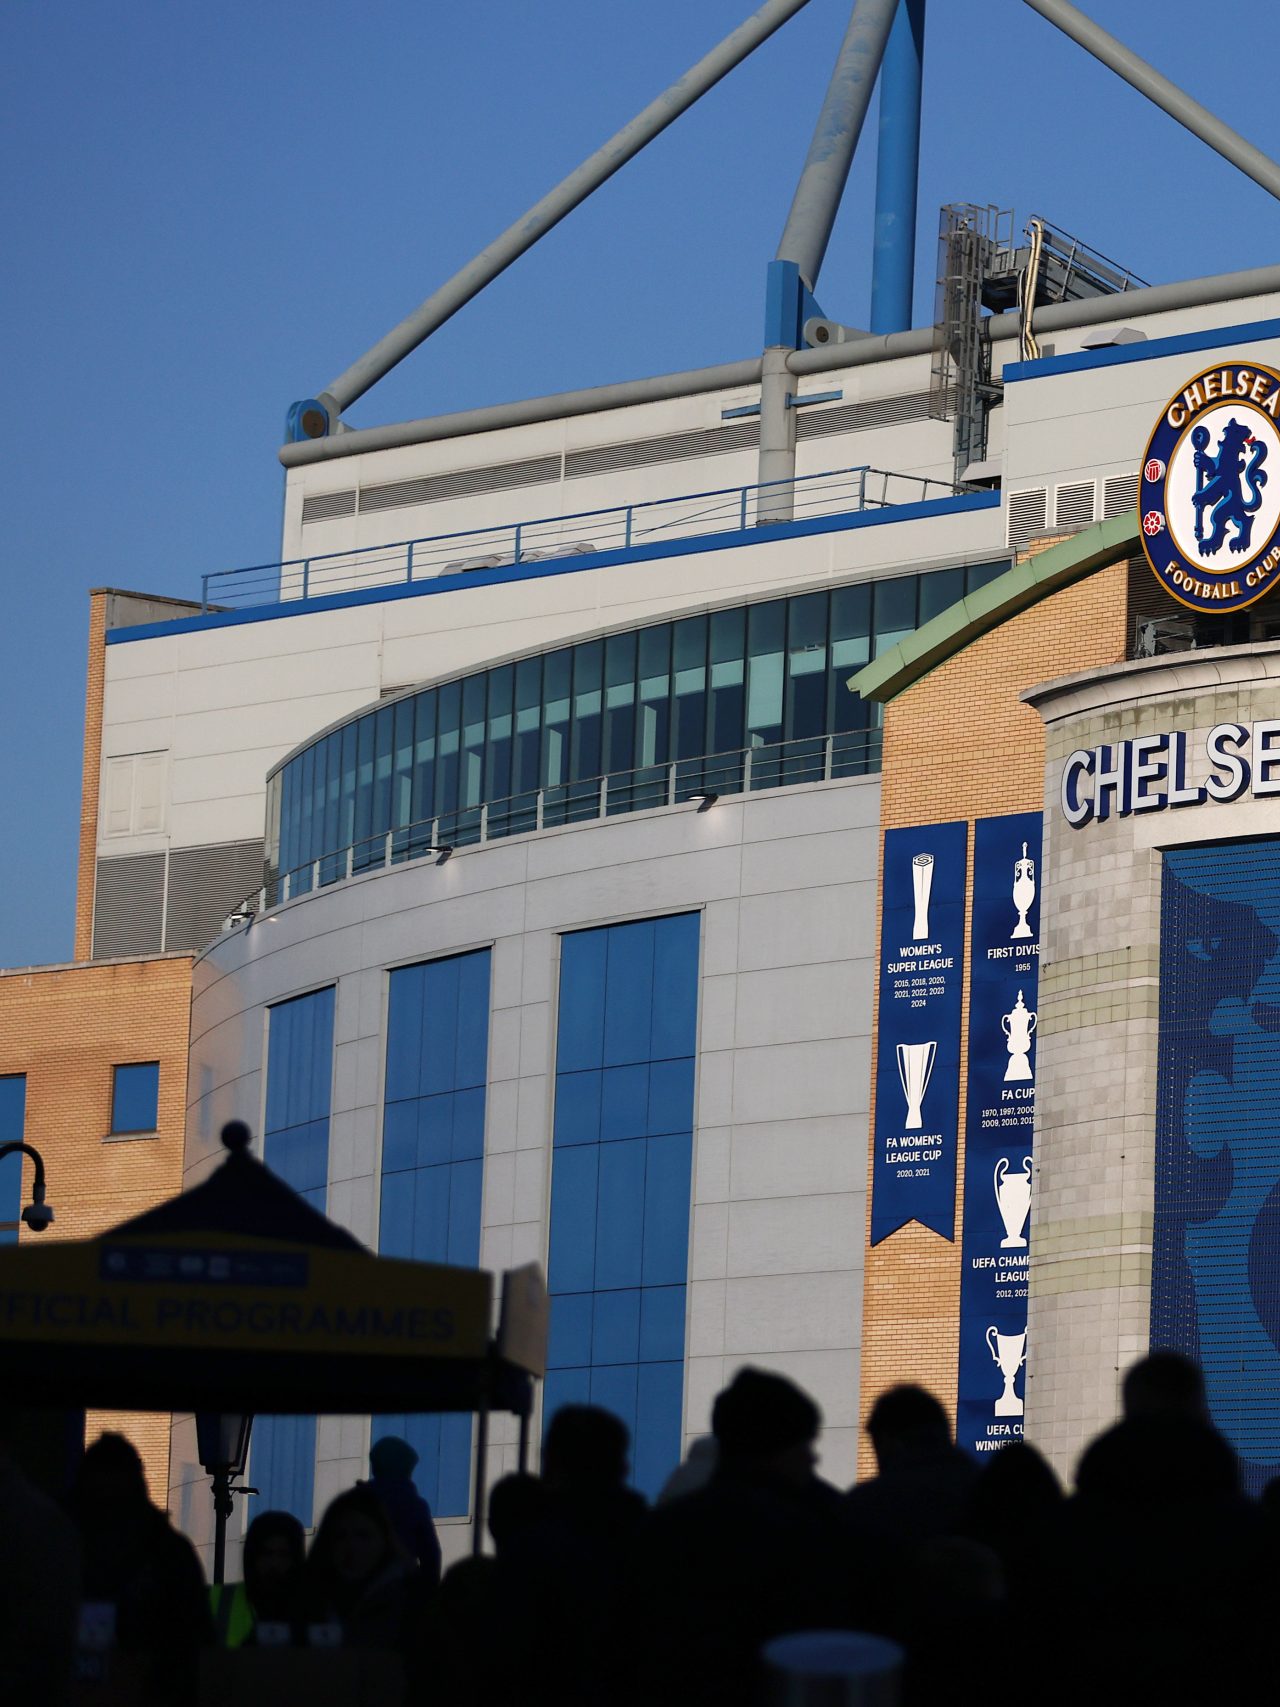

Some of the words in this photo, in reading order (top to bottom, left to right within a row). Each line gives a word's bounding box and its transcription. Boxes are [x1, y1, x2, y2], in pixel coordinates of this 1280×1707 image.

[1164, 561, 1242, 600] FOOTBALL
[900, 944, 942, 957] WOMEN'S
[987, 947, 1014, 959] FIRST
[887, 961, 917, 973] SUPER
[919, 958, 953, 970] LEAGUE
[1015, 963, 1031, 971] 1955
[894, 979, 910, 988] 2015,
[911, 978, 927, 986] 2018,
[928, 976, 945, 985] 2020,
[894, 990, 910, 998] 2021,
[911, 988, 928, 997] 2022,
[929, 987, 944, 995] 2023
[911, 999, 926, 1007] 2024
[1001, 1090, 1014, 1100] FA
[1015, 1088, 1035, 1099] CUP
[982, 1109, 998, 1117] 1970,
[1000, 1108, 1015, 1116] 1997,
[981, 1119, 1000, 1128] 2009,
[1001, 1118, 1019, 1126] 2010,
[886, 1138, 898, 1148] FA
[900, 1134, 942, 1147] WOMEN'S
[886, 1151, 921, 1163] LEAGUE
[922, 1150, 942, 1161] CUP
[897, 1169, 914, 1178] 2020,
[915, 1168, 930, 1176] 2021
[972, 1257, 997, 1269] UEFA
[996, 1290, 1013, 1298] 2012,
[0, 1293, 141, 1330] FICIAL
[156, 1299, 456, 1341] PROGRAMMES
[987, 1425, 1011, 1435] UEFA
